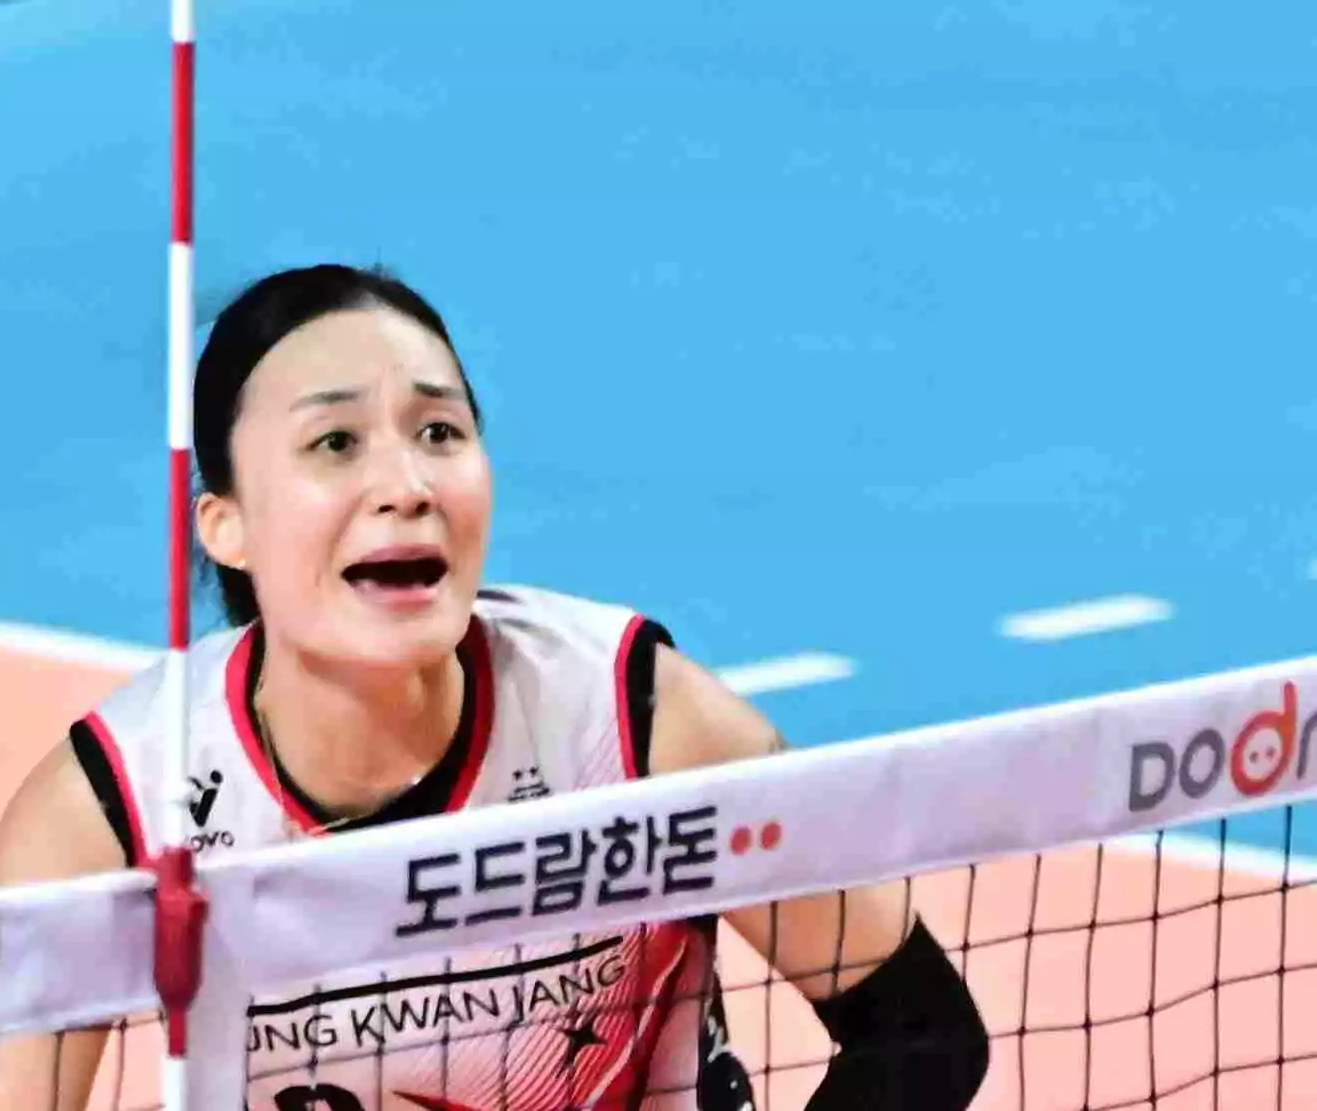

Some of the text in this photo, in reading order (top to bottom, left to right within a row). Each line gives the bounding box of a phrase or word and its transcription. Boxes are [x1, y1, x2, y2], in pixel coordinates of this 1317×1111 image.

[395, 805, 719, 938] 도드람한돈
[351, 989, 497, 1047] KWAN
[513, 954, 626, 1023] JANG
